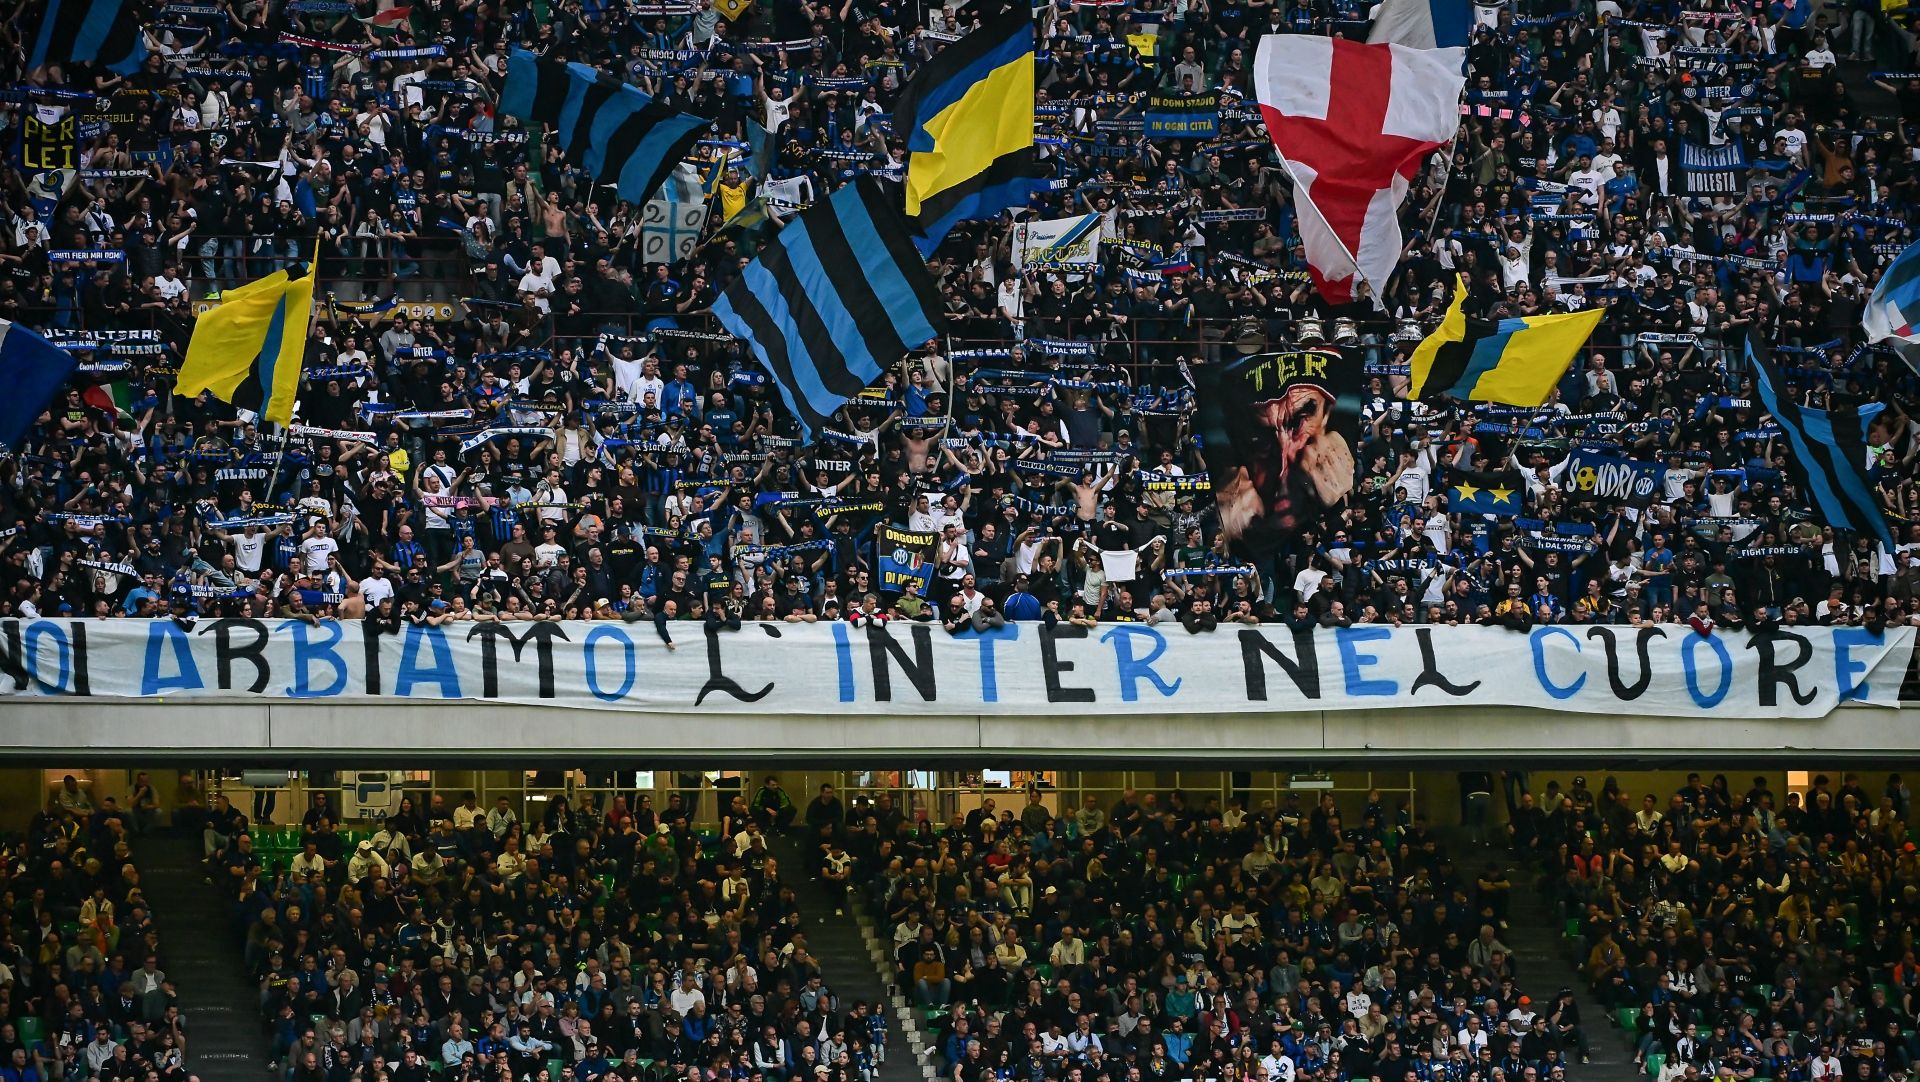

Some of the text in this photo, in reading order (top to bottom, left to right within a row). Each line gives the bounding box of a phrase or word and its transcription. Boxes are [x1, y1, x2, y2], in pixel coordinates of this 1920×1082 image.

[1705, 86, 1731, 97] INTER
[1150, 96, 1216, 108] IN OGNI STADIO
[1740, 107, 1762, 115] INTER
[24, 115, 75, 143] PER
[1152, 121, 1163, 131] IN
[1165, 121, 1187, 131] OGNI
[1190, 118, 1213, 131] CITTÀ
[24, 145, 74, 169] LEI
[1684, 144, 1740, 167] TRASFERTA
[1049, 179, 1068, 190] INTER
[1688, 171, 1737, 192] MOLESTA
[1811, 213, 1835, 222] NORD
[1581, 228, 1600, 240] INTER
[1126, 237, 1151, 249] DELLA
[72, 251, 90, 260] FIERI
[91, 251, 103, 260] MAI
[1126, 267, 1164, 282] MILANO
[111, 343, 162, 355] MILANO
[413, 346, 433, 358] INTER
[1052, 347, 1087, 356] DAL 1908
[1731, 398, 1751, 408] INTER
[1598, 422, 1649, 434] CN 69
[946, 438, 968, 449] FORZA
[815, 459, 851, 472] INTER
[1016, 460, 1079, 474] FOREVER ULTRAS
[215, 468, 267, 480] MILANO
[1147, 482, 1176, 490] JUVE
[1179, 482, 1192, 490] TI
[436, 496, 453, 505] INTER
[781, 491, 799, 499] INTER
[816, 501, 884, 518] NOI DELLA NORD
[1016, 495, 1067, 515] TI AMO
[1545, 542, 1581, 551] DAL 1908
[1741, 546, 1800, 557] FIGHT FOR US
[103, 561, 138, 578] CURVA
[1378, 559, 1428, 571] INTER
[885, 571, 896, 583] DI
[323, 593, 344, 604] INTER
[0, 620, 91, 696] NOI
[141, 617, 636, 702] ABBIAMO
[1237, 625, 1481, 702] NEL
[1530, 625, 1886, 708] CUORE
[359, 808, 388, 818] FILA
